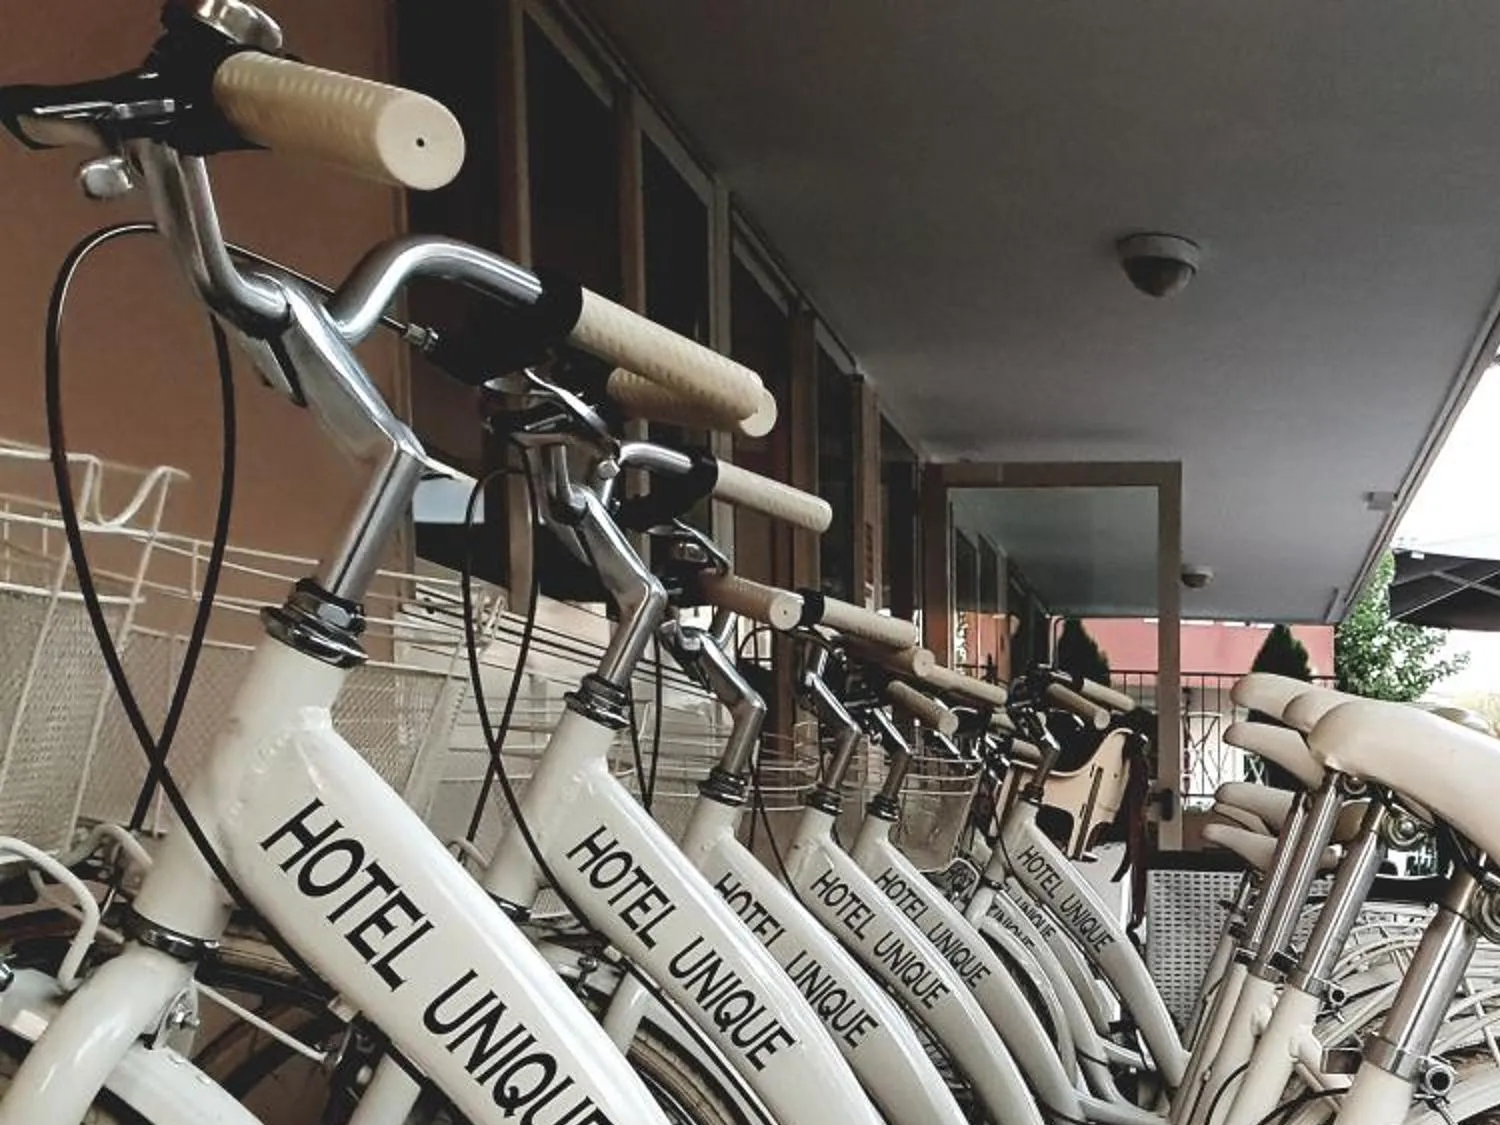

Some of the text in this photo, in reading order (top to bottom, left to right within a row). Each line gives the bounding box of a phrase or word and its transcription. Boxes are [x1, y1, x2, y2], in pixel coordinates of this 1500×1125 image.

[259, 797, 435, 992] HOTEL
[566, 825, 795, 1072] HOTEL UNIQUE
[810, 869, 951, 1010] HOTEL UNIQUE
[874, 867, 991, 988] HOTEL UNIQUE
[1017, 844, 1115, 953] HOTEL UNIQUE
[785, 950, 879, 1048] UNIQUE
